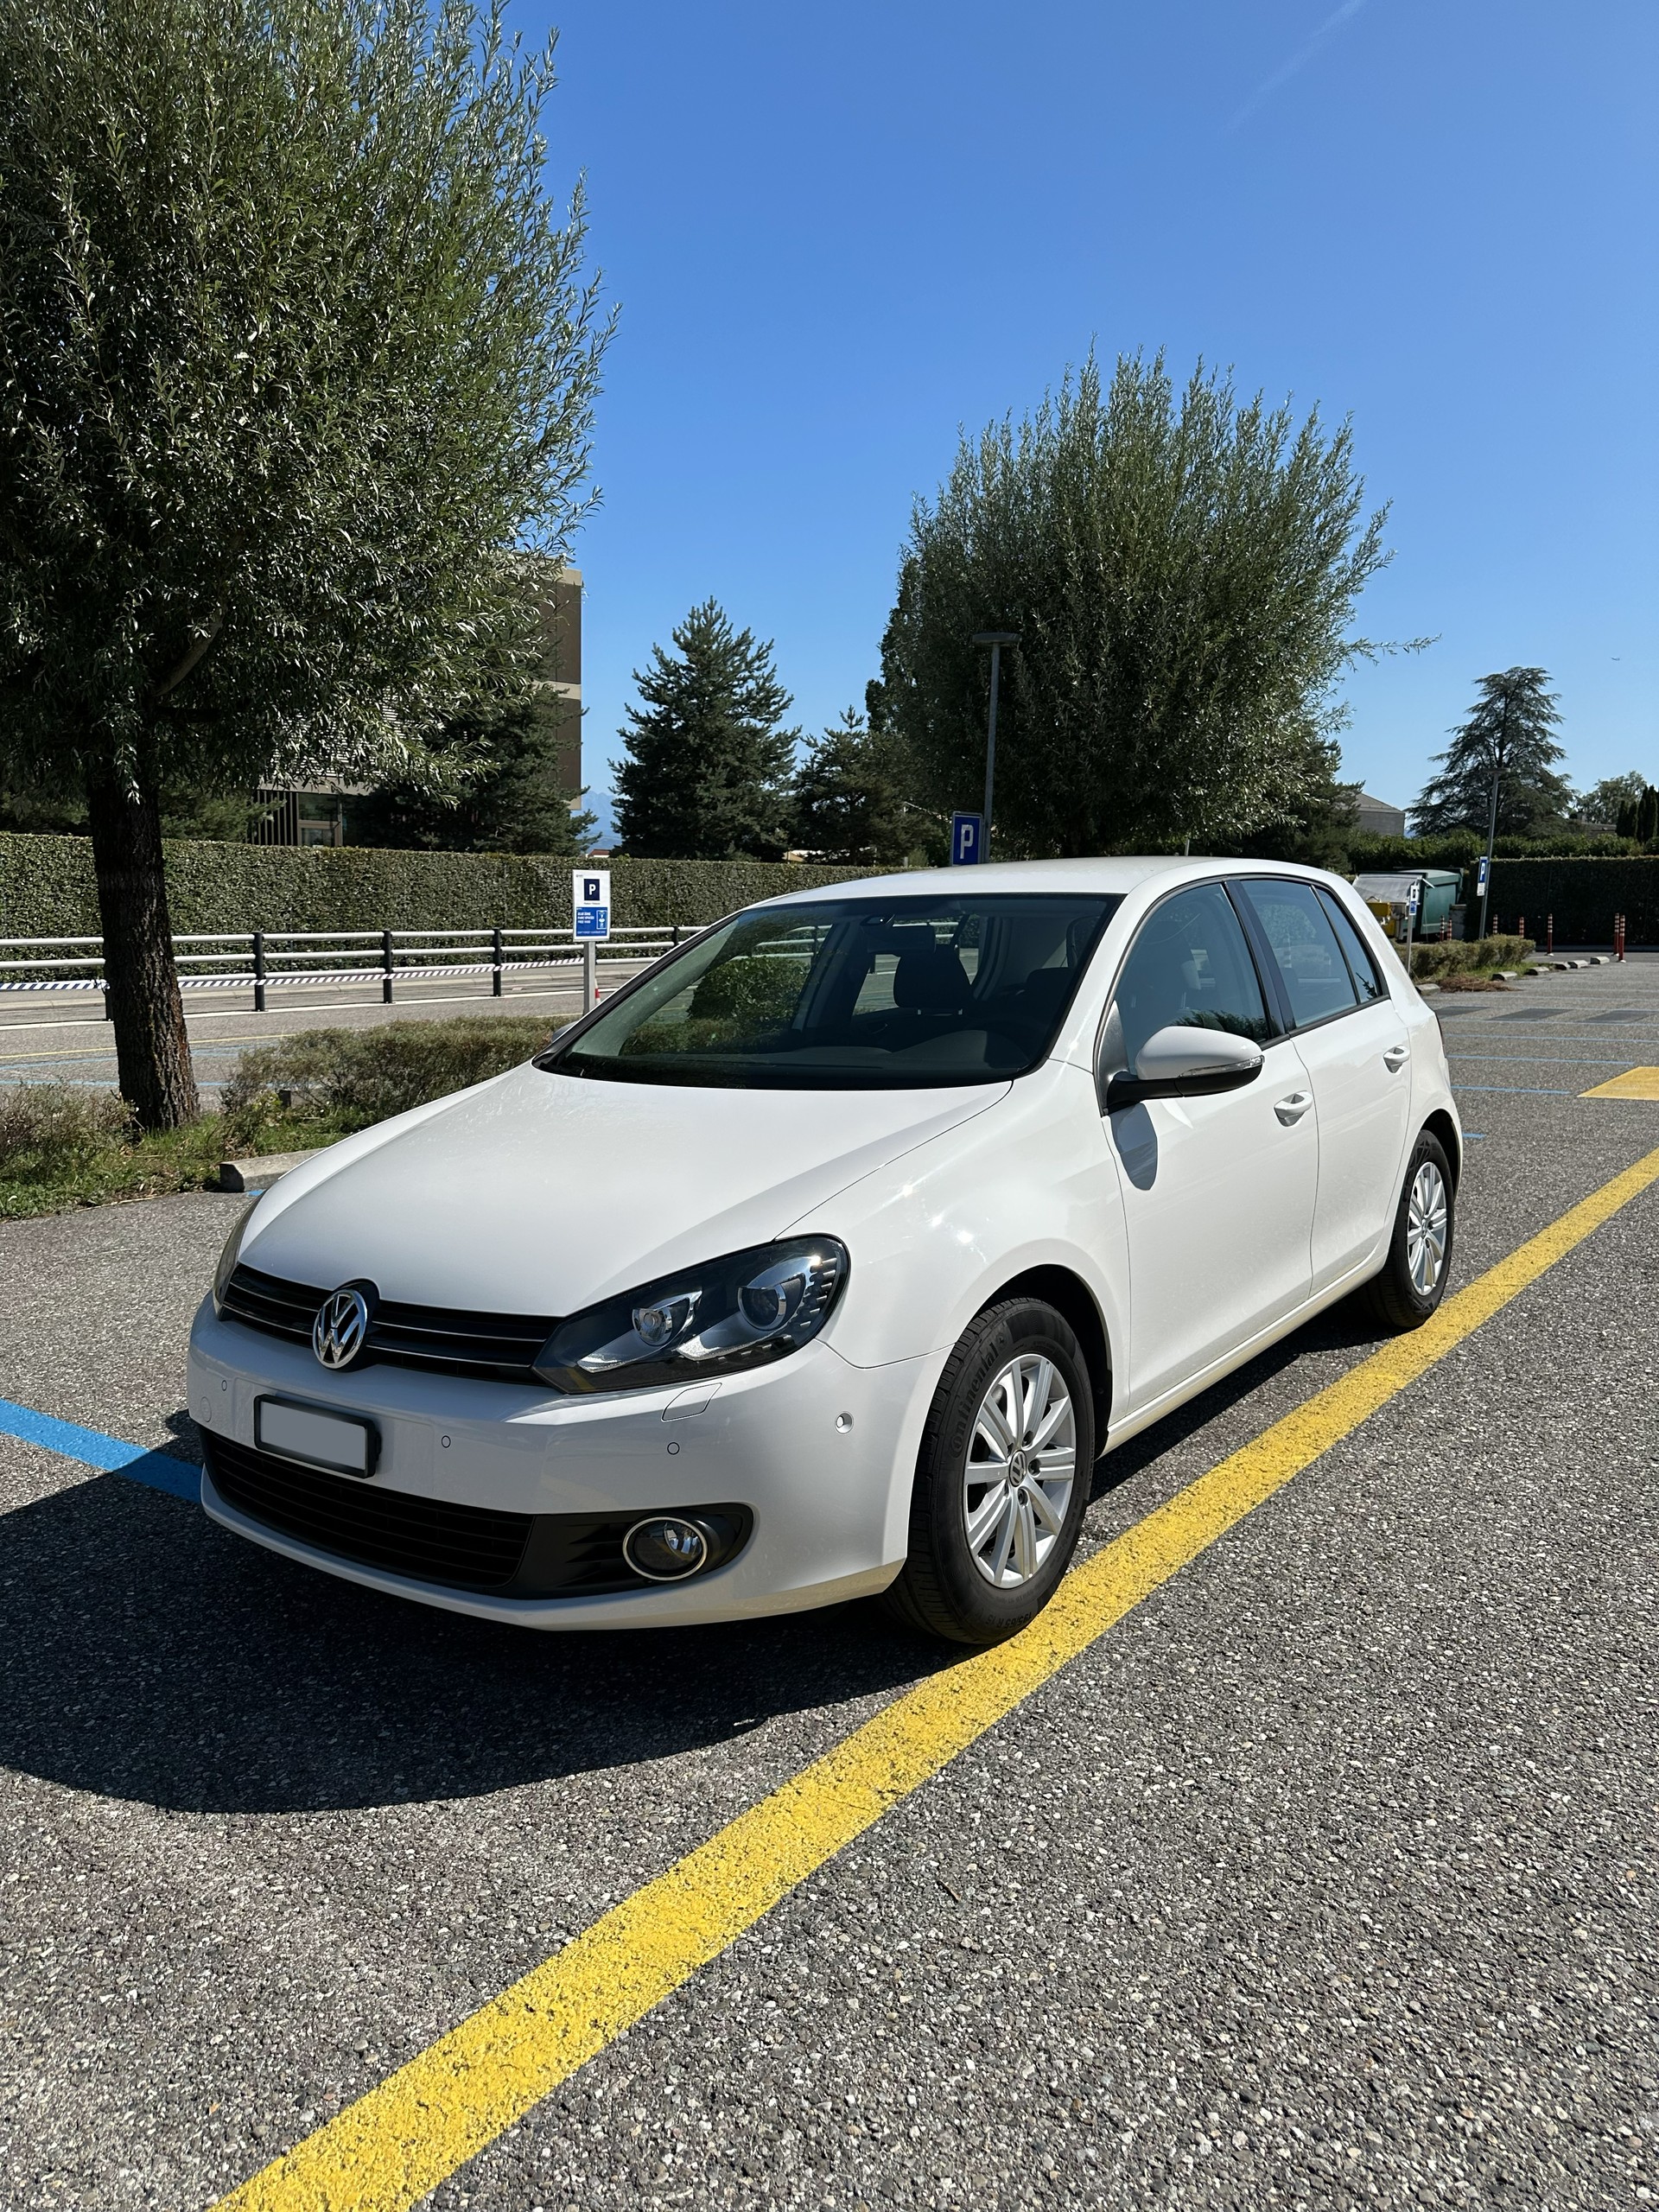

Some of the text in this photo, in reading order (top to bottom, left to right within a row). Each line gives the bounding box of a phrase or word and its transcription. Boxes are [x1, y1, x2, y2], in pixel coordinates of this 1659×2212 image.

[960, 823, 974, 859] P
[1480, 862, 1485, 880] P
[588, 884, 596, 895] P
[315, 1292, 365, 1365] VW
[951, 1342, 1000, 1458] Continental
